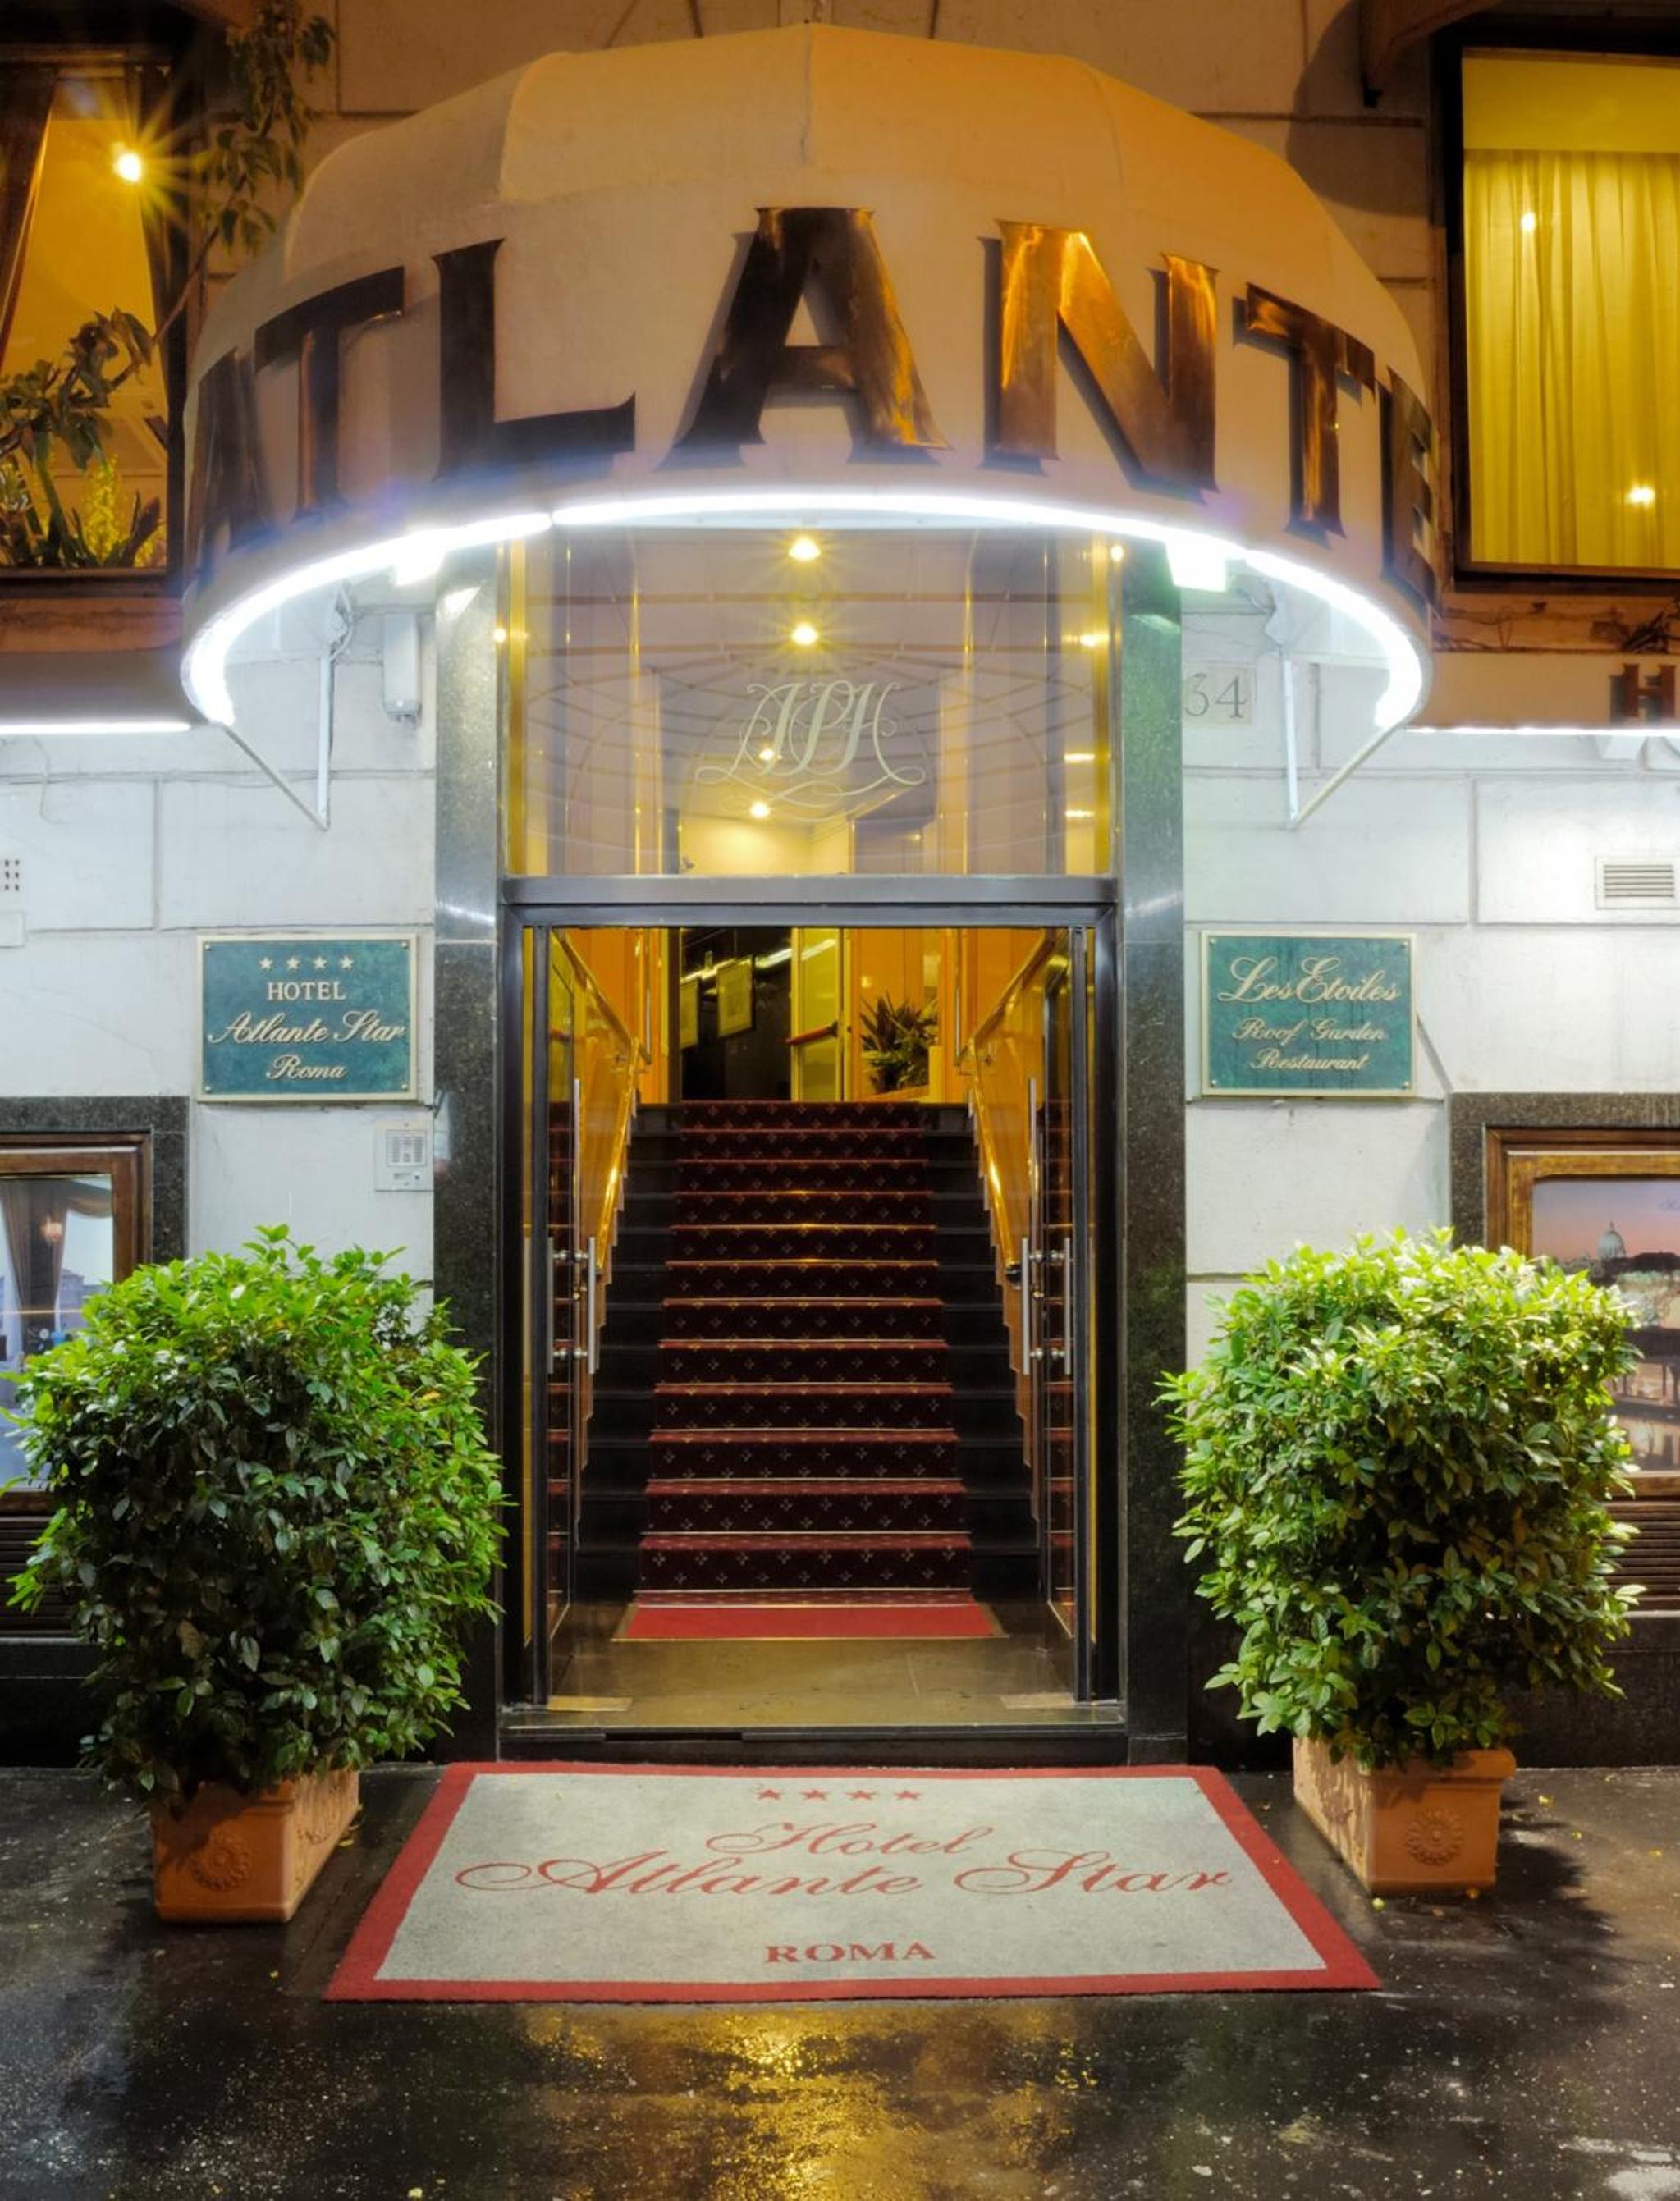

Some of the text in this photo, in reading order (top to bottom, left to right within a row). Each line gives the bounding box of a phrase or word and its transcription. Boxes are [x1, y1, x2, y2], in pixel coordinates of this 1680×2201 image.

[184, 207, 1443, 620] ATLANTE
[1185, 672, 1248, 719] 34
[267, 982, 346, 1000] HOTEL
[1218, 956, 1295, 1003] Les
[208, 1009, 406, 1044] Atlante Star
[1233, 1017, 1387, 1046] Roof Garden
[265, 1053, 346, 1079] Roma
[1250, 1047, 1370, 1071] Restaurant
[706, 1822, 994, 1855] Hotel
[455, 1848, 1233, 1895] Atlante Star
[762, 1942, 937, 1963] ROMA
